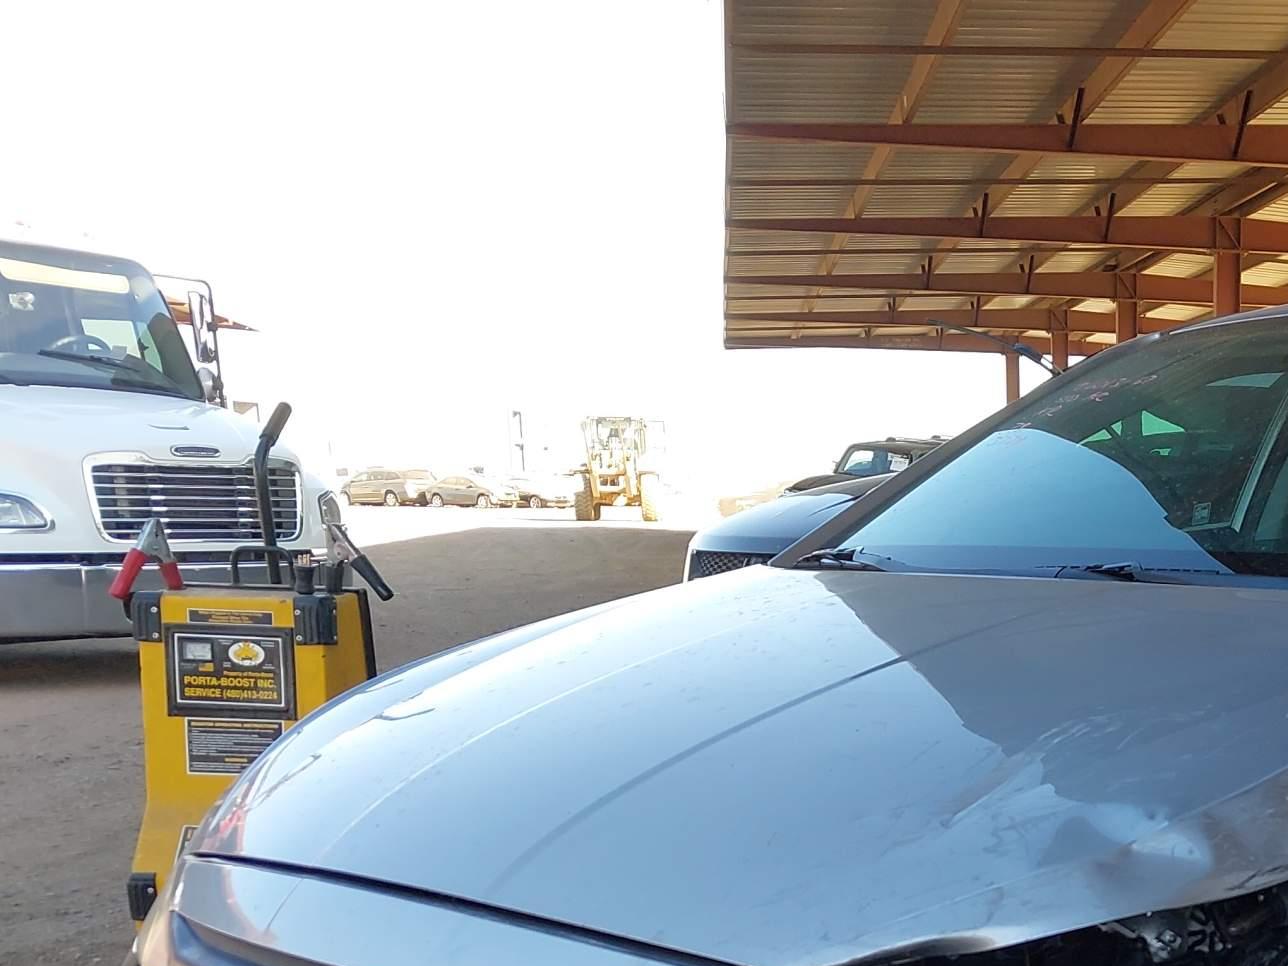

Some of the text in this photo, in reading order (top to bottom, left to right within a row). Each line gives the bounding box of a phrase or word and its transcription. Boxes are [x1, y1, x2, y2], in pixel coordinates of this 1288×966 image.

[184, 676, 277, 689] PORTA-BOOST INC.
[184, 688, 222, 698] SERVICE
